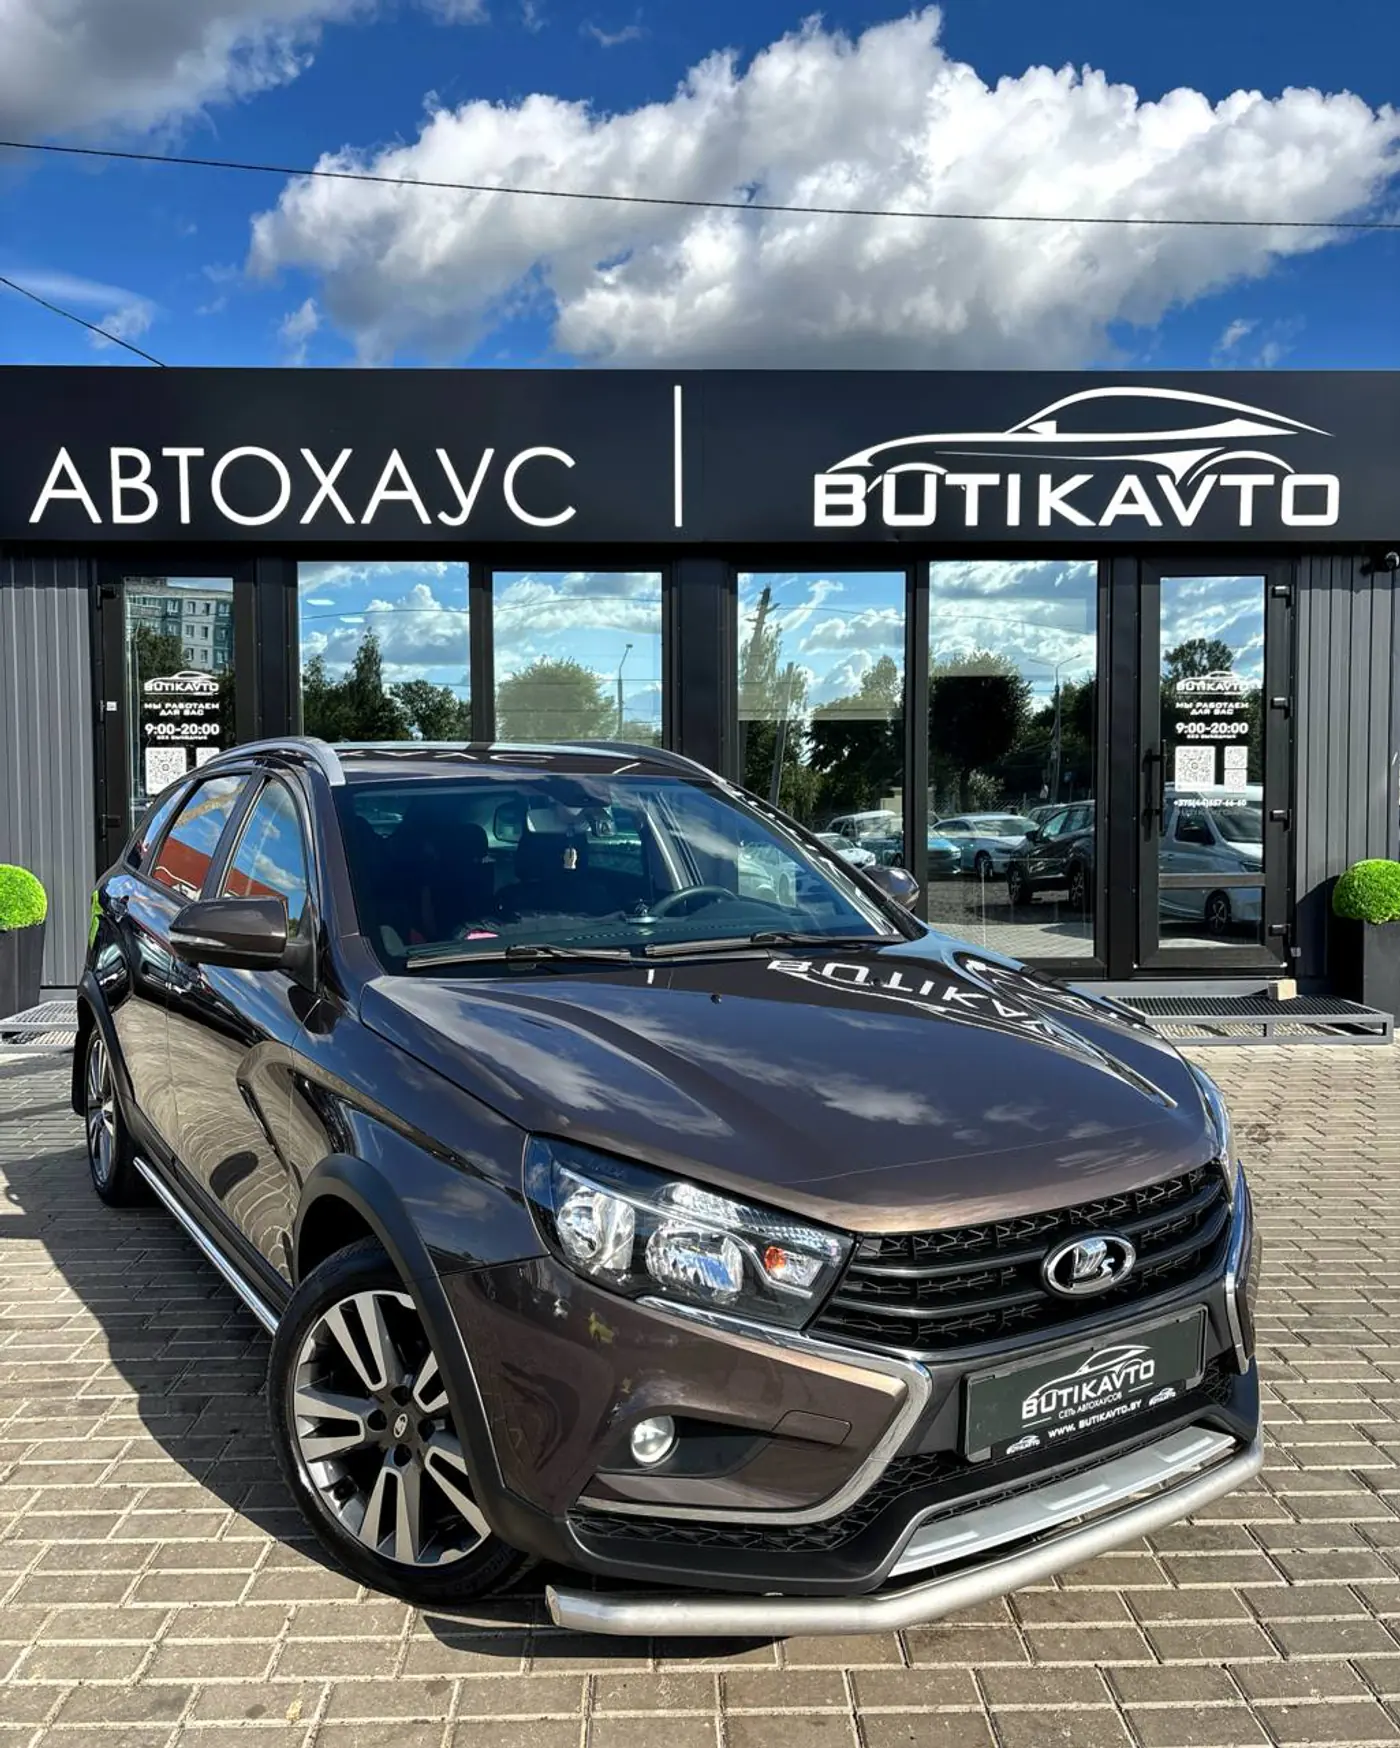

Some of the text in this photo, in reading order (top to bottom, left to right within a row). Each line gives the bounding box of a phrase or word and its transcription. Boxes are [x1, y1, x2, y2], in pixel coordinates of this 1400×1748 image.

[29, 446, 578, 528] АВТОХАУС
[813, 473, 1340, 527] BUTIKAVTO
[144, 682, 219, 691] BUTIKAVTO
[144, 723, 220, 735] 9:00-20:00
[1175, 722, 1249, 734] 9:00-20:00
[1022, 1359, 1155, 1420] BUTIKAVTO
